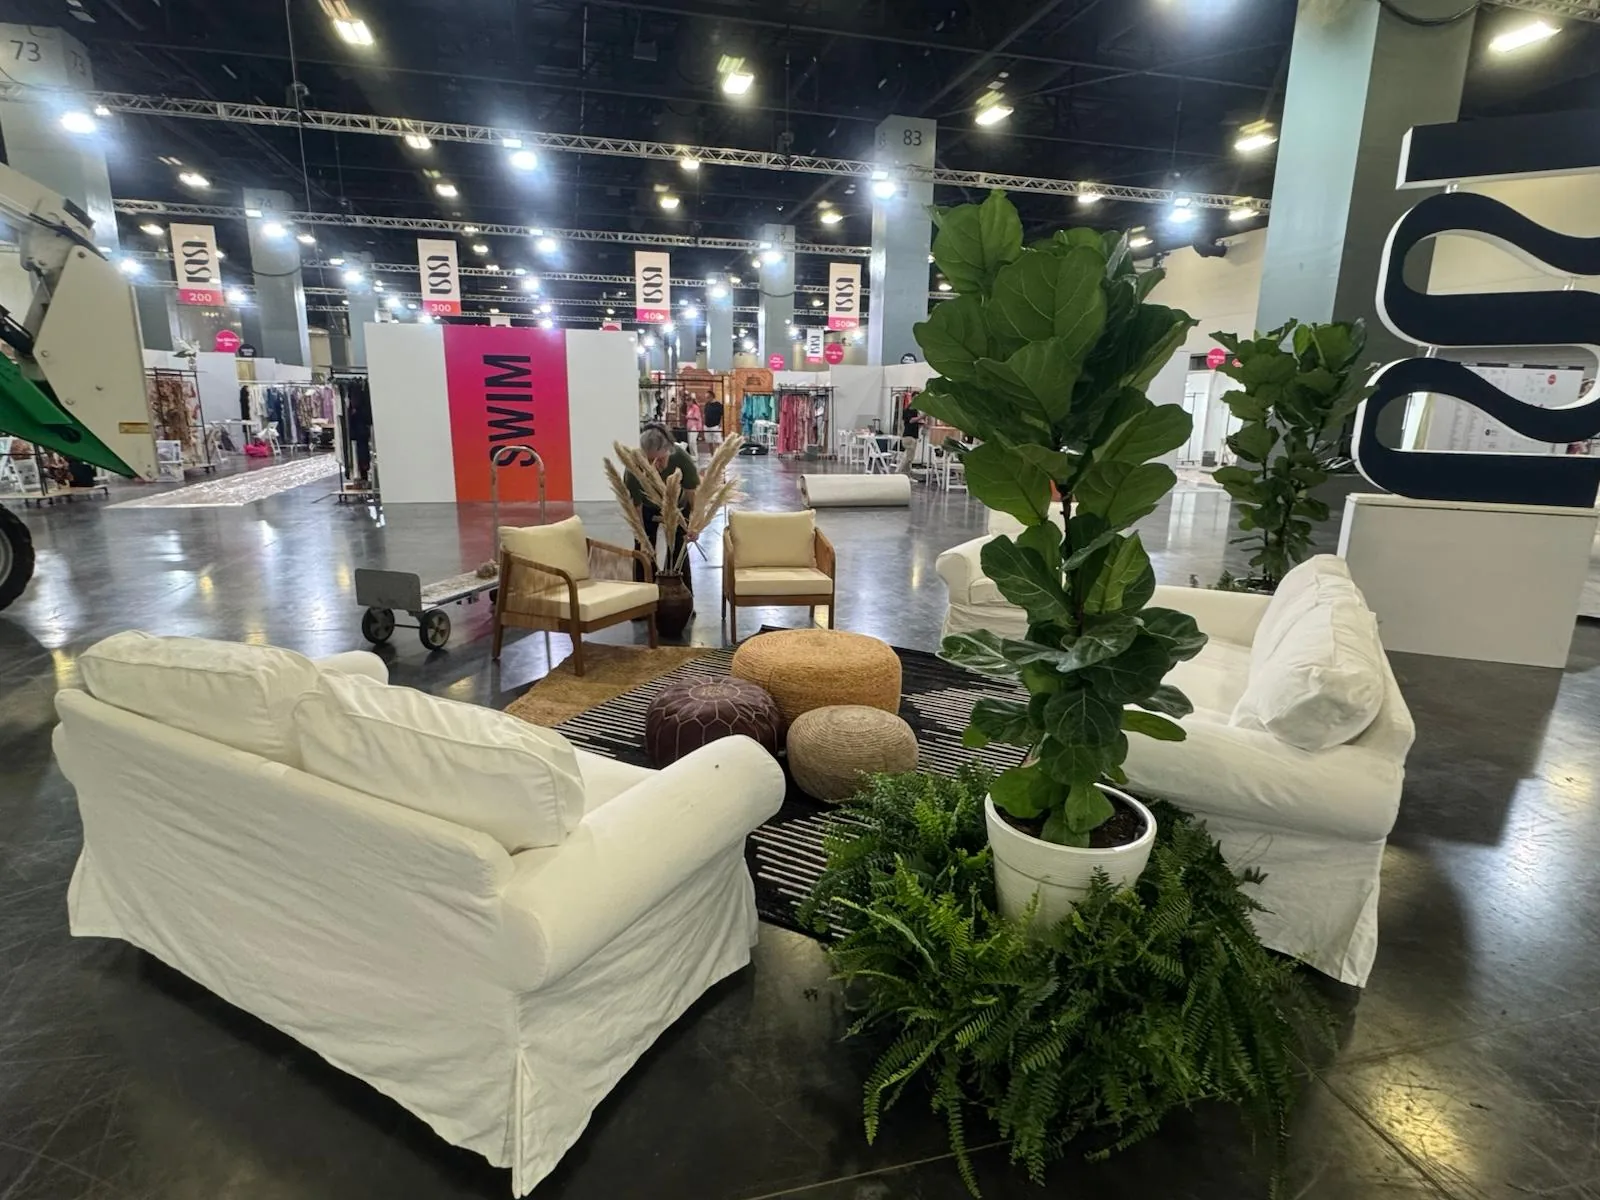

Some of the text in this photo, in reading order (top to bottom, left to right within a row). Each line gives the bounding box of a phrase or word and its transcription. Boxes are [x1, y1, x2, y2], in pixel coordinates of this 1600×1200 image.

[10, 39, 41, 62] 73
[903, 129, 921, 146] 83
[189, 293, 213, 303] 200
[431, 303, 452, 312] 300
[483, 354, 537, 467] SWIM
